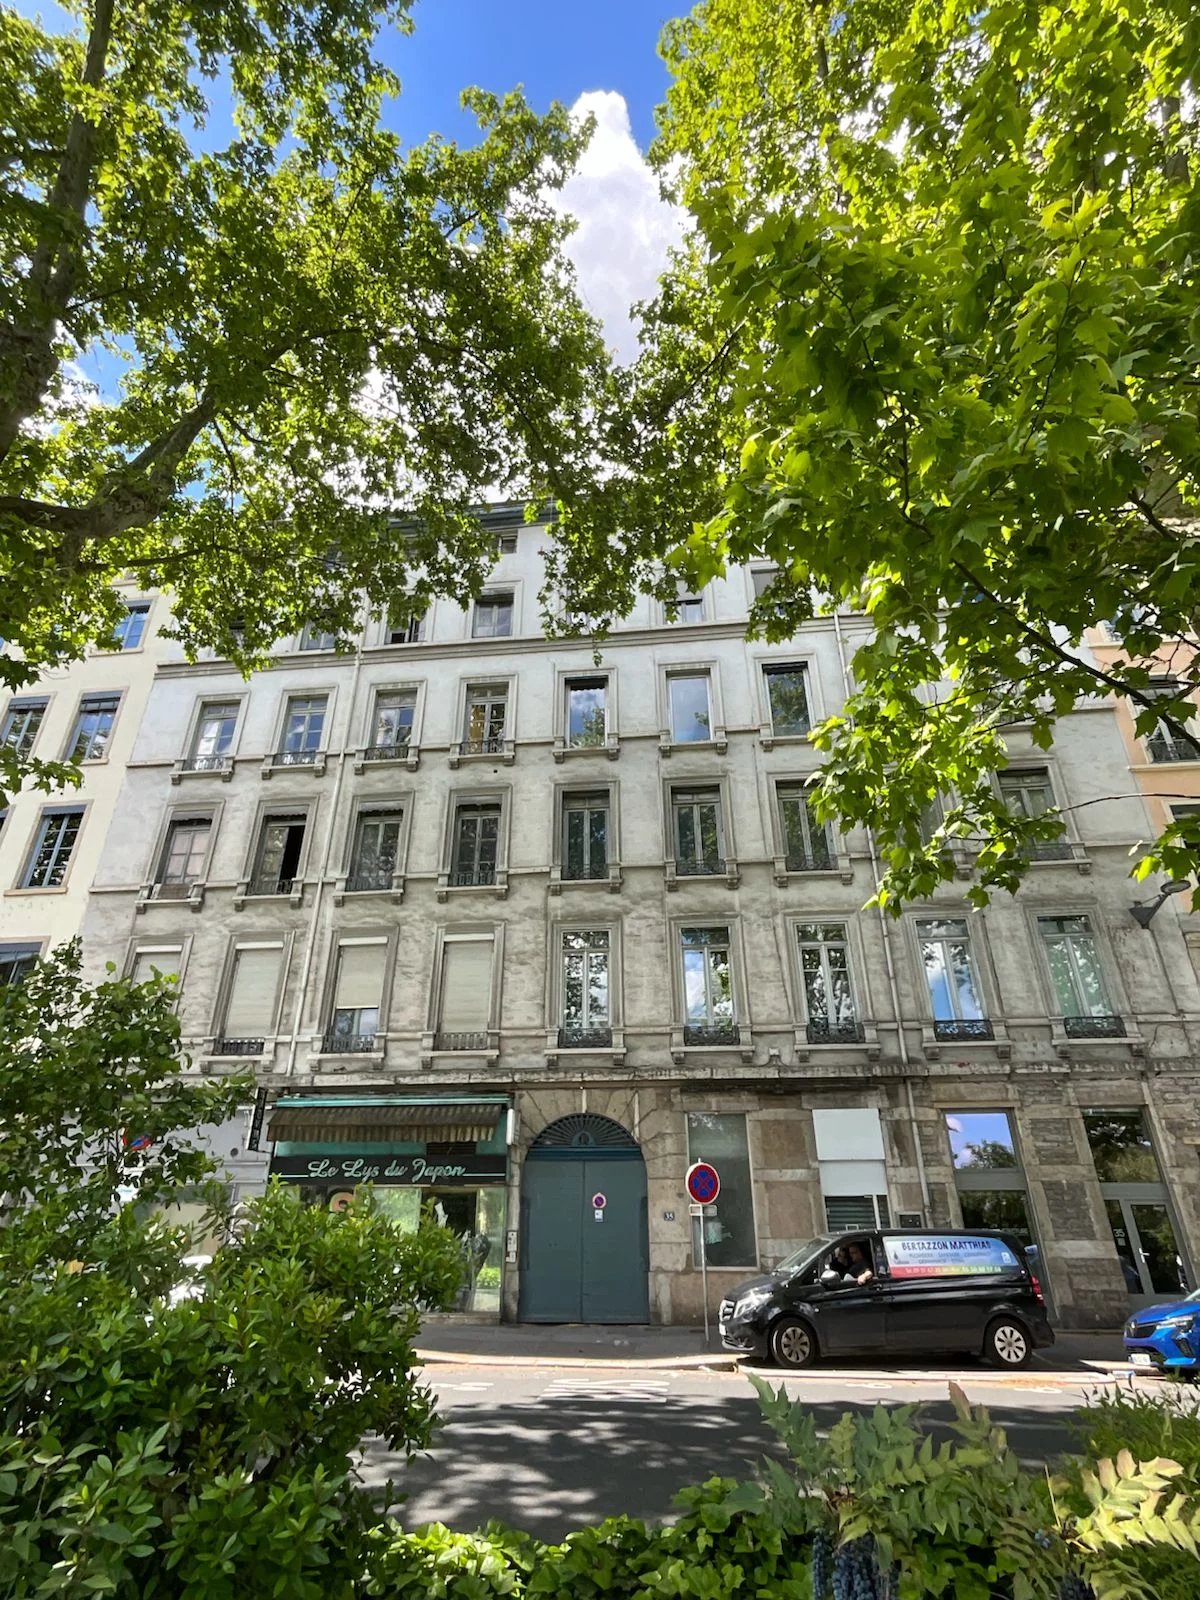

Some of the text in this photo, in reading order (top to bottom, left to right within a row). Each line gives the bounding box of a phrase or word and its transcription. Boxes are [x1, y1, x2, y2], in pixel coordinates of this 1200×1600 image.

[308, 1158, 465, 1184] Le Lys du Japon
[902, 1240, 949, 1251] BERTAZZON
